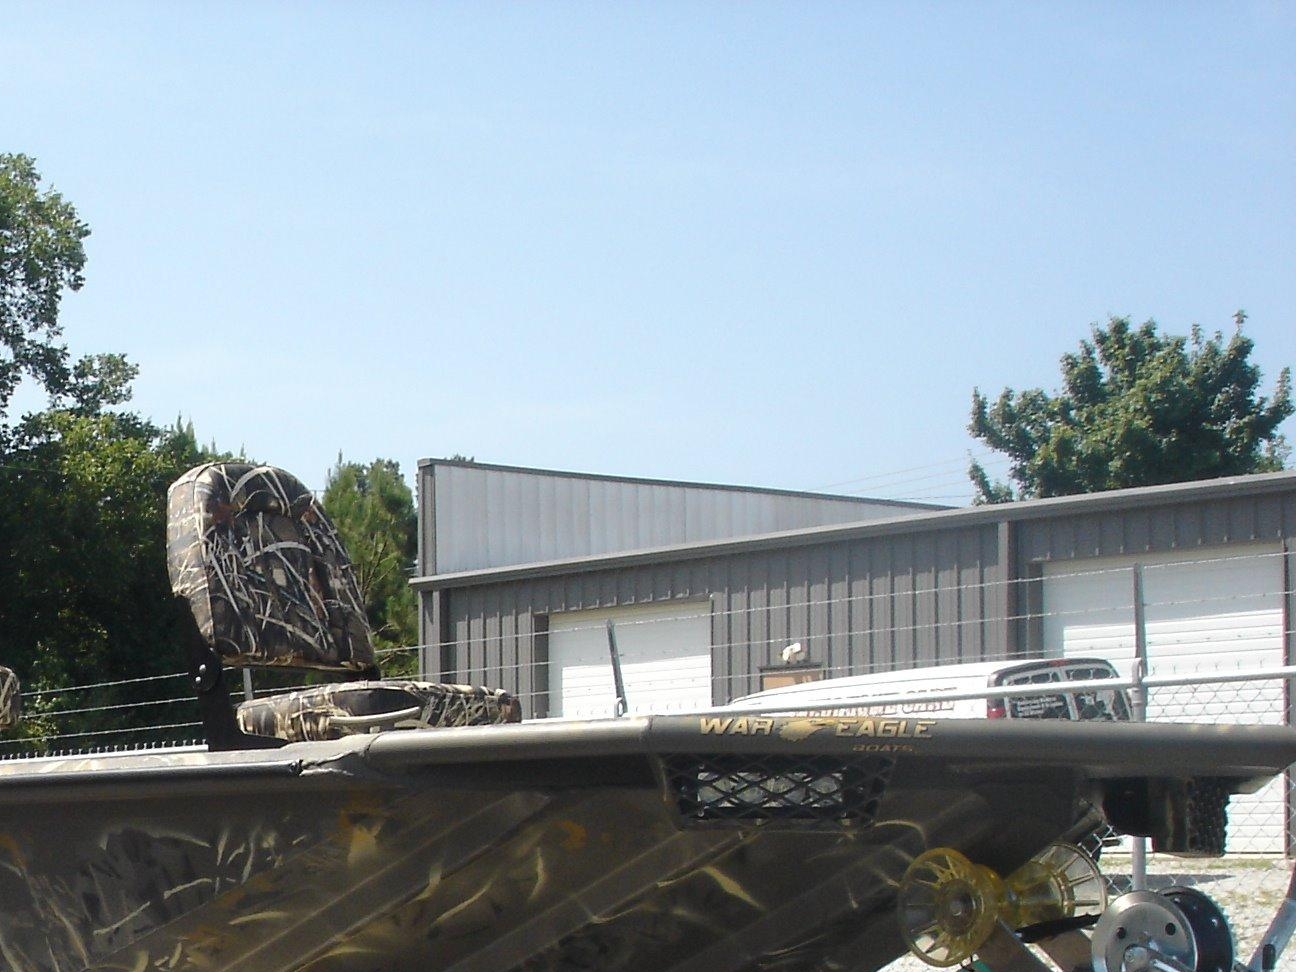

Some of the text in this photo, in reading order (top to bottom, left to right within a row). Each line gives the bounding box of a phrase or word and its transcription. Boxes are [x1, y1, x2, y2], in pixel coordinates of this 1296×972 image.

[700, 717, 936, 739] WAR EAGLE
[852, 743, 913, 752] BOATS
